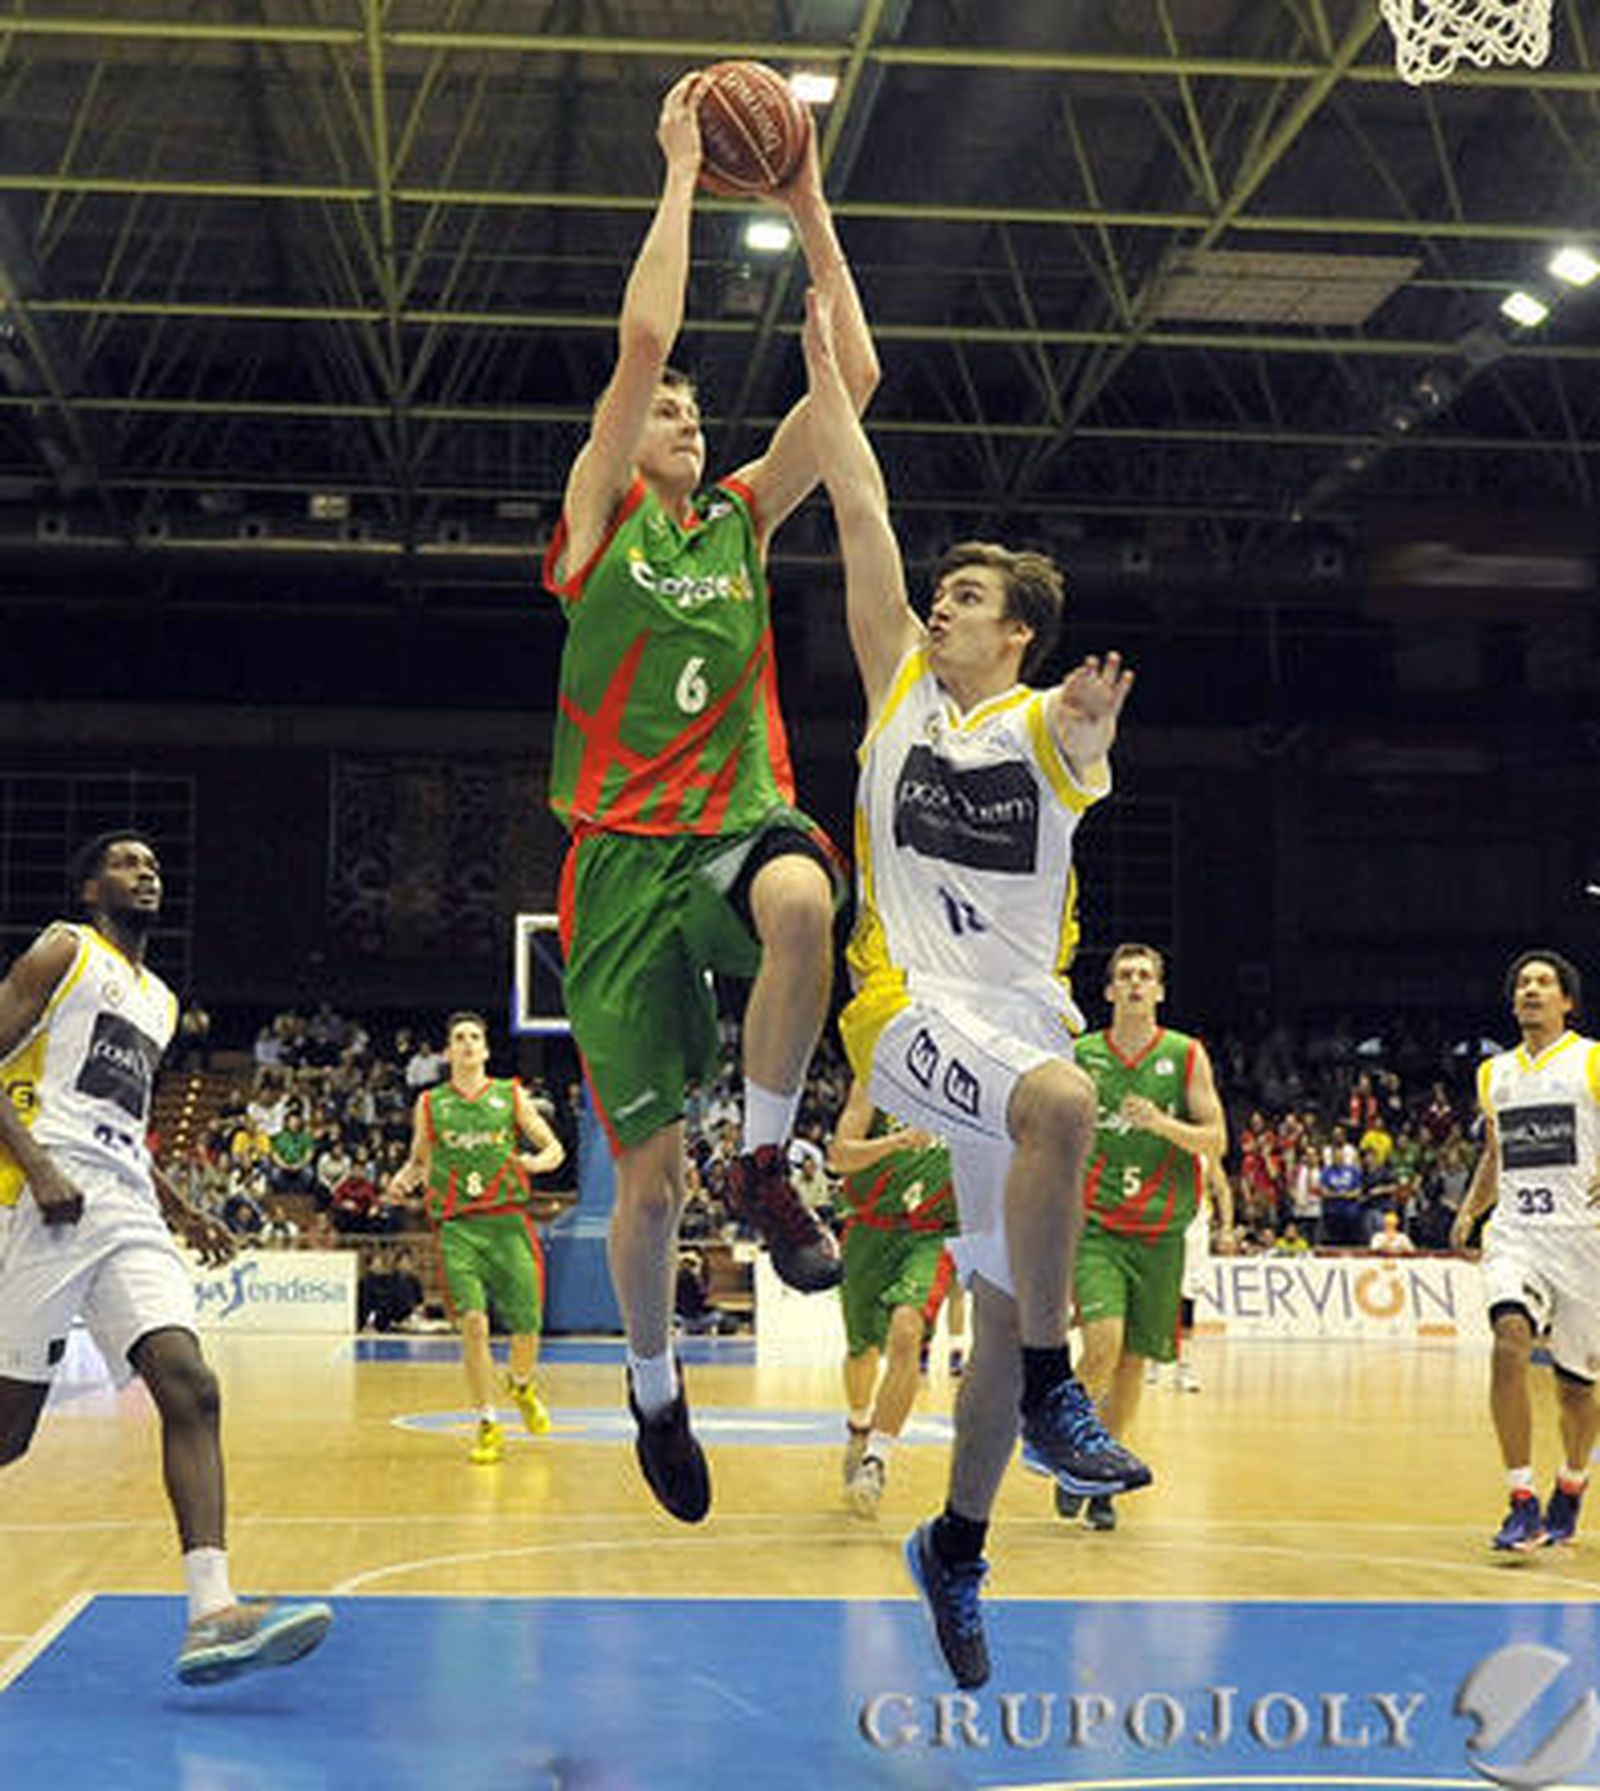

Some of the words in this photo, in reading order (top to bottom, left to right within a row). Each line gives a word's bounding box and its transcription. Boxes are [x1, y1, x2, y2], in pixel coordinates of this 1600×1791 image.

[675, 656, 710, 714] 6
[466, 1171, 483, 1196] 8
[1122, 1166, 1143, 1197] 5
[1516, 1187, 1555, 1215] 33
